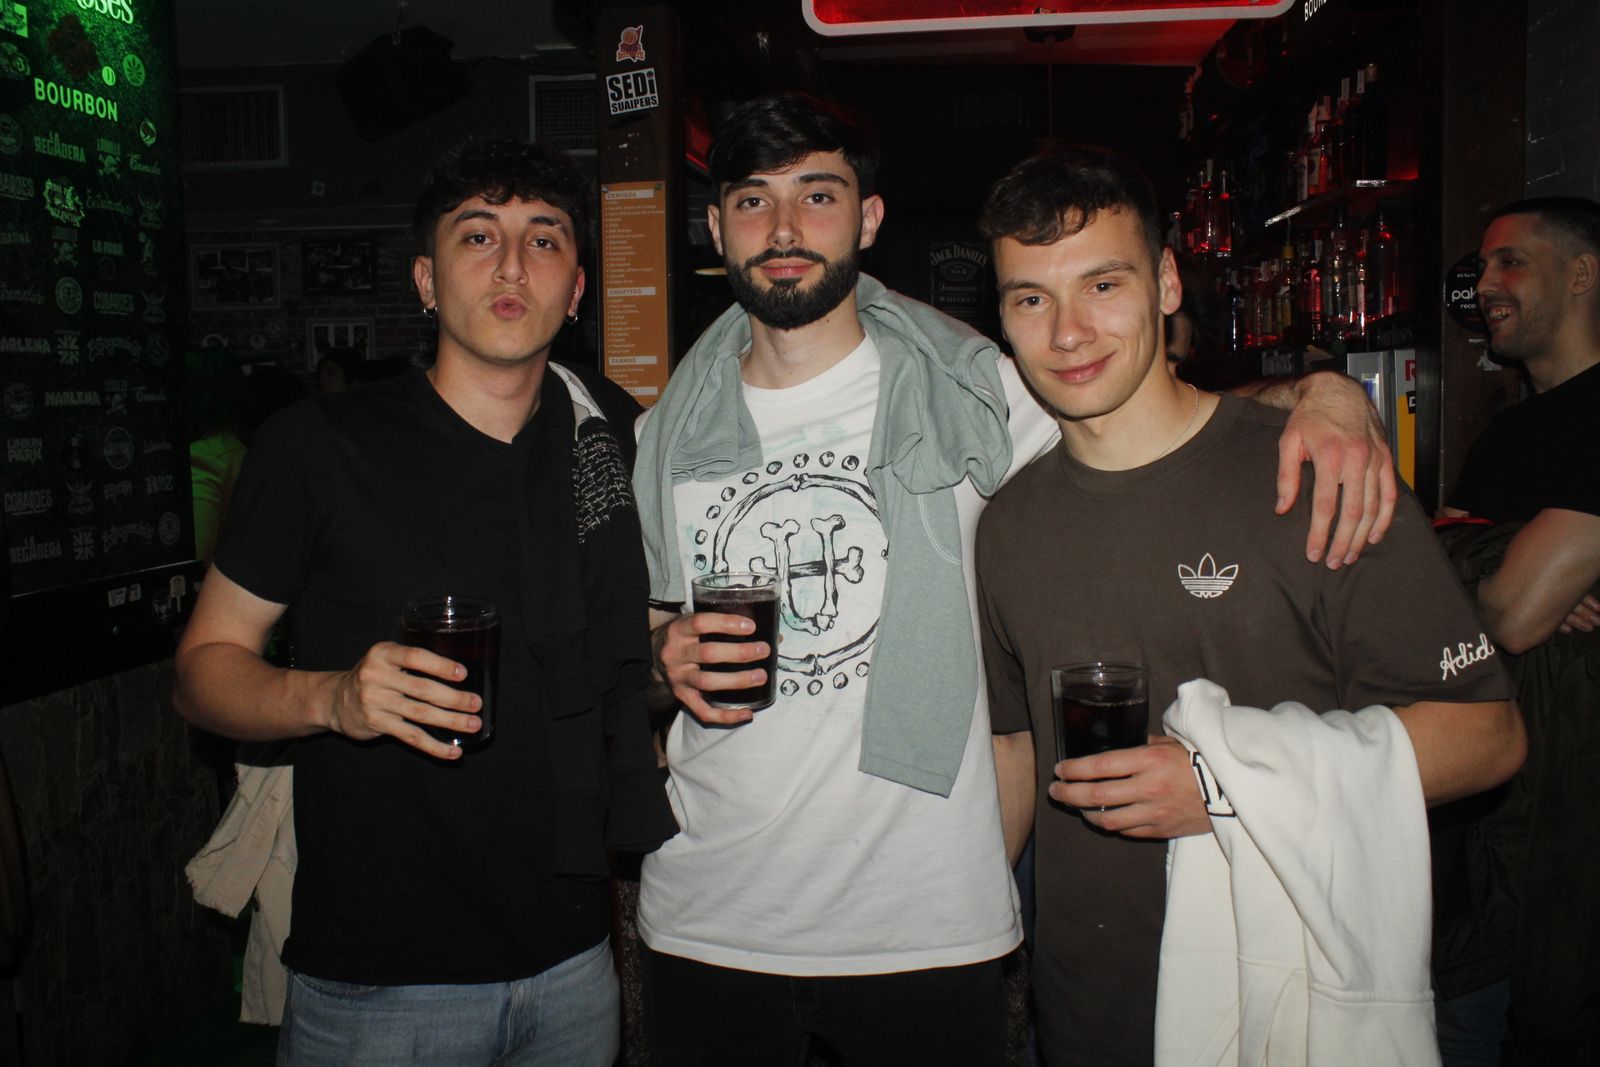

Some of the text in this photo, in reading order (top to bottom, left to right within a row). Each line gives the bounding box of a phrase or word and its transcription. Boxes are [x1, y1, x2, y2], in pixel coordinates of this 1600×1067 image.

[1304, 0, 1327, 22] BOU
[33, 77, 119, 122] BOURBON
[611, 95, 658, 113] SUAIPERS
[33, 136, 86, 164] REGADERA
[930, 247, 953, 266] JACK
[1451, 286, 1477, 302] pak
[0, 336, 51, 354] ARLENA
[45, 391, 101, 408] MARLENA
[8, 448, 44, 465] PARK
[8, 539, 63, 564] REGADERA
